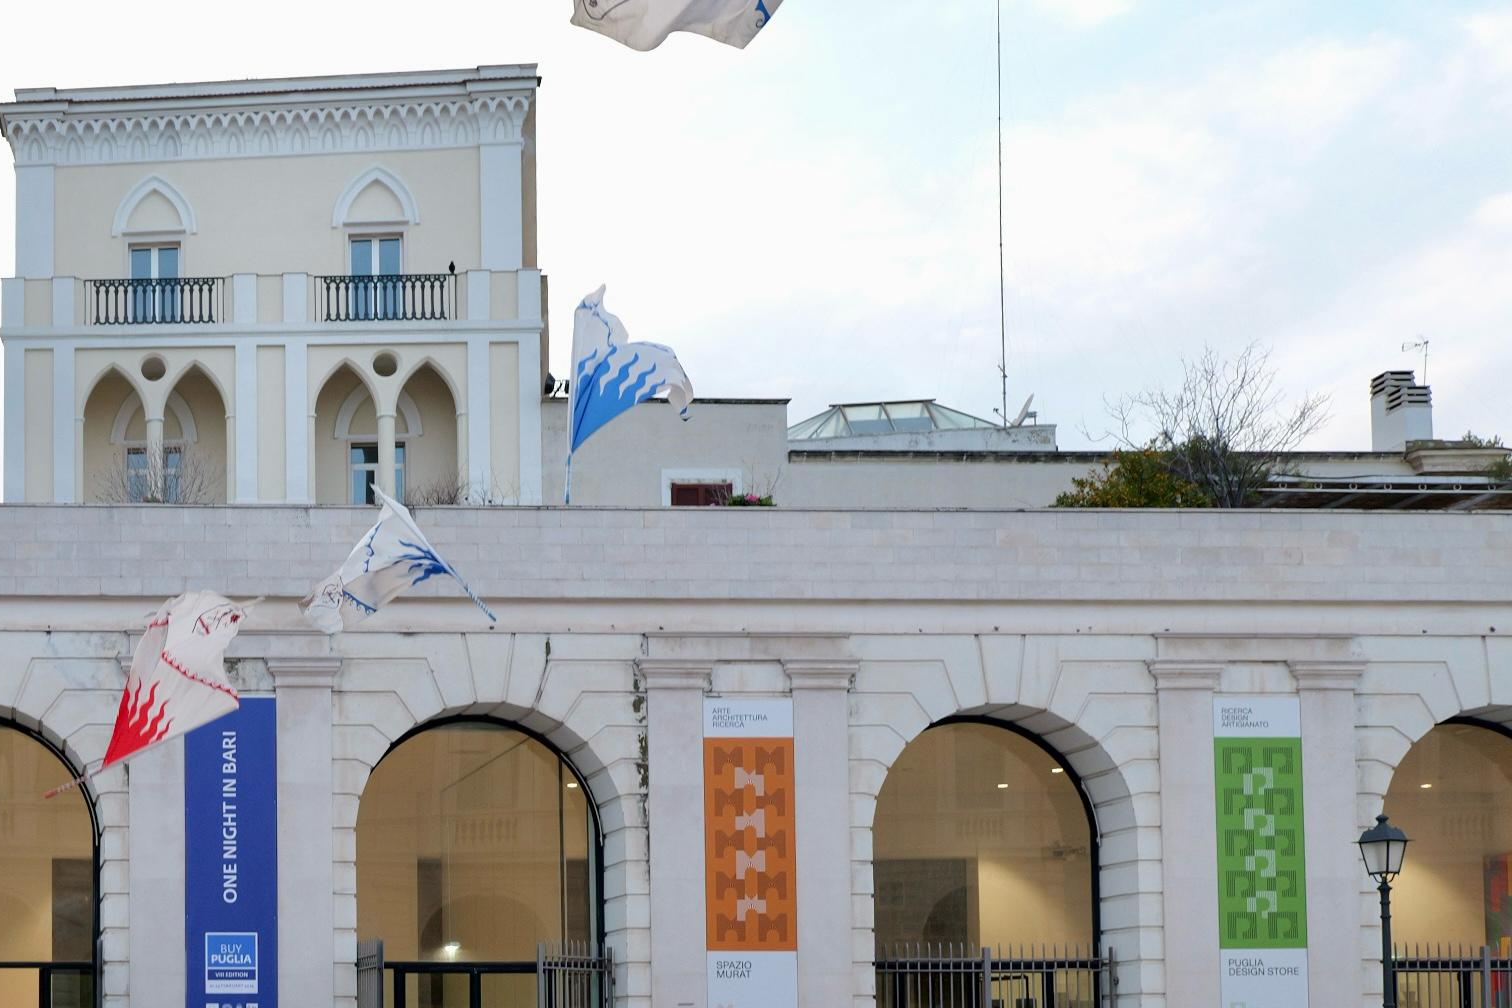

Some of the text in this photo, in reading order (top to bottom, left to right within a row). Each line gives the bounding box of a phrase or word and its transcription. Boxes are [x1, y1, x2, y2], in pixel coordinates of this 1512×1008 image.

[222, 730, 238, 904] ONE NIGHT IN BARI
[220, 943, 242, 953] BUY
[211, 954, 252, 964] PUGLIA
[1228, 958, 1264, 967] PUGLIA
[716, 960, 752, 970] SPAZIO
[716, 969, 752, 979] MURAT
[1228, 966, 1300, 976] DESIGN STORE
